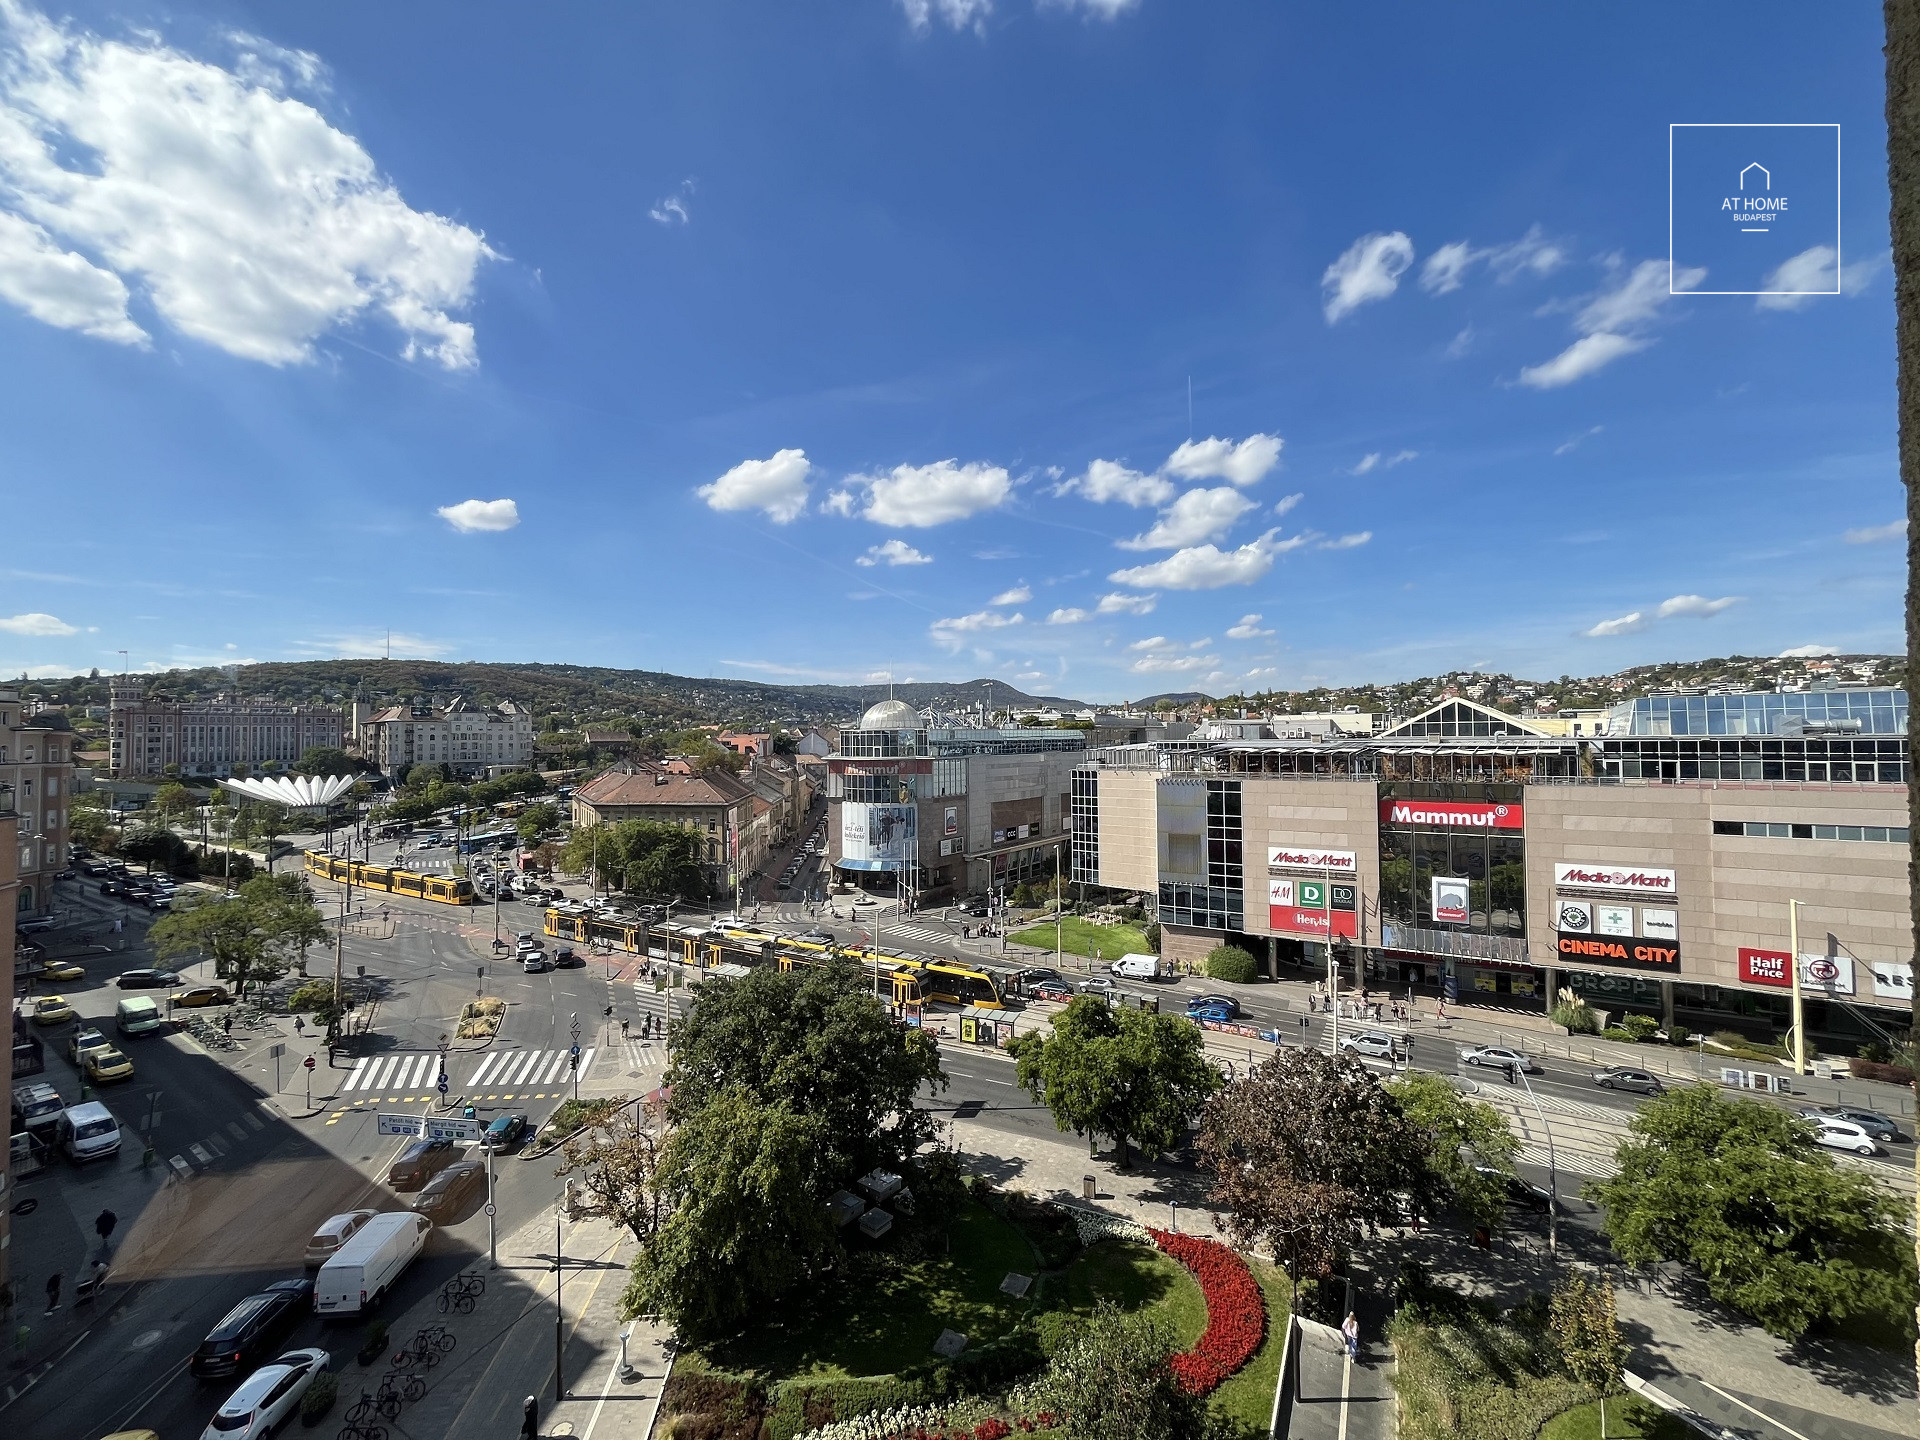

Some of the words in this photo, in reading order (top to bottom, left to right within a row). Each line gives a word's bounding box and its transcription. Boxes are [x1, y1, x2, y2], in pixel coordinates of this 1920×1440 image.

[1296, 913, 1329, 927] Hervis
[1559, 938, 1629, 959] CINEMA
[1633, 945, 1678, 963] CITY
[1749, 955, 1784, 969] Half
[1750, 966, 1784, 979] Price
[1569, 974, 1647, 994] CROPP
